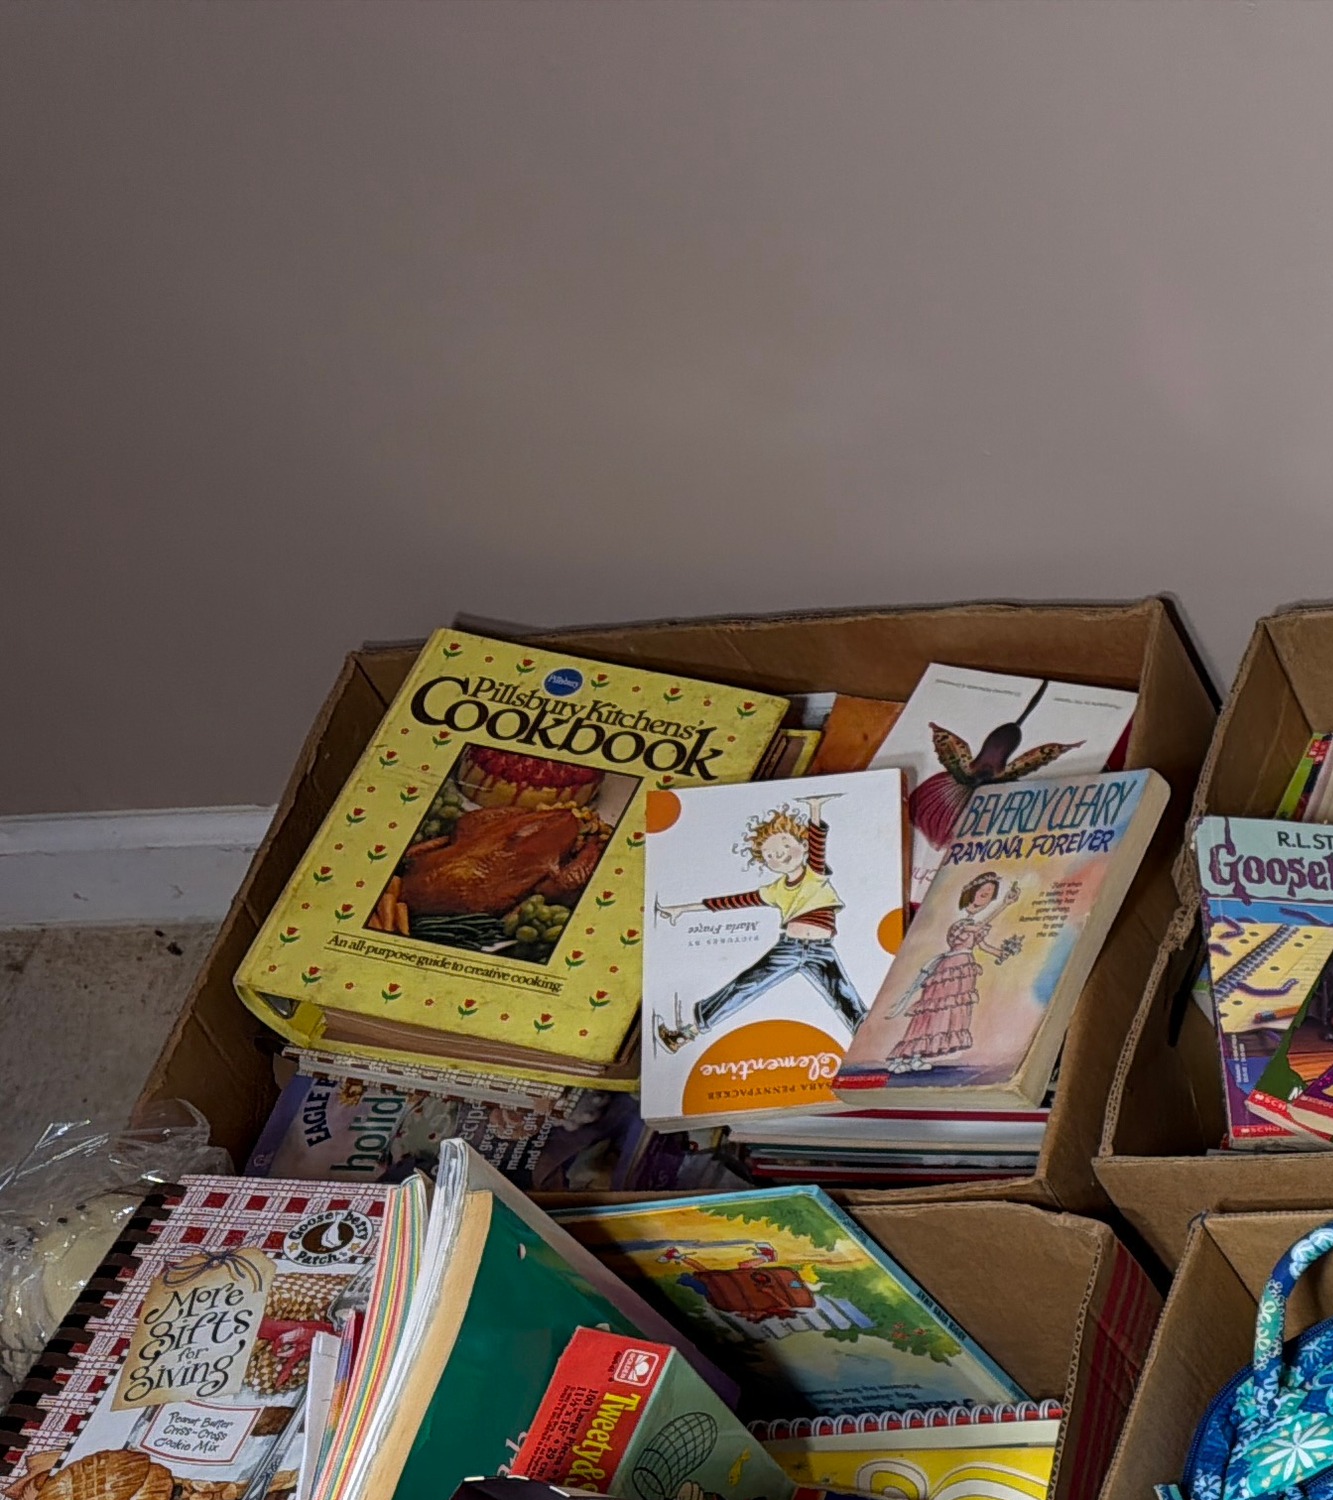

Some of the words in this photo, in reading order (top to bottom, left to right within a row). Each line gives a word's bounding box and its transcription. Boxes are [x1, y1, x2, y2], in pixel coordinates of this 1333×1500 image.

[468, 676, 588, 719] Pillsbury
[411, 676, 724, 781] Cookbook
[957, 786, 1056, 839] BEVERLY
[1048, 780, 1136, 831] CLEARY
[947, 836, 1023, 866] RAMONA
[1026, 829, 1115, 858] FOREVER
[348, 936, 416, 963] all-purpose
[416, 954, 452, 971] guide
[464, 964, 511, 981] creative
[700, 1052, 842, 1081] Clementine
[707, 1083, 797, 1101] PENNYPACKER
[303, 1090, 334, 1148] EAGLE
[144, 1283, 245, 1327] More
[168, 1411, 201, 1428] Peanut
[154, 1437, 190, 1452] Cookie
